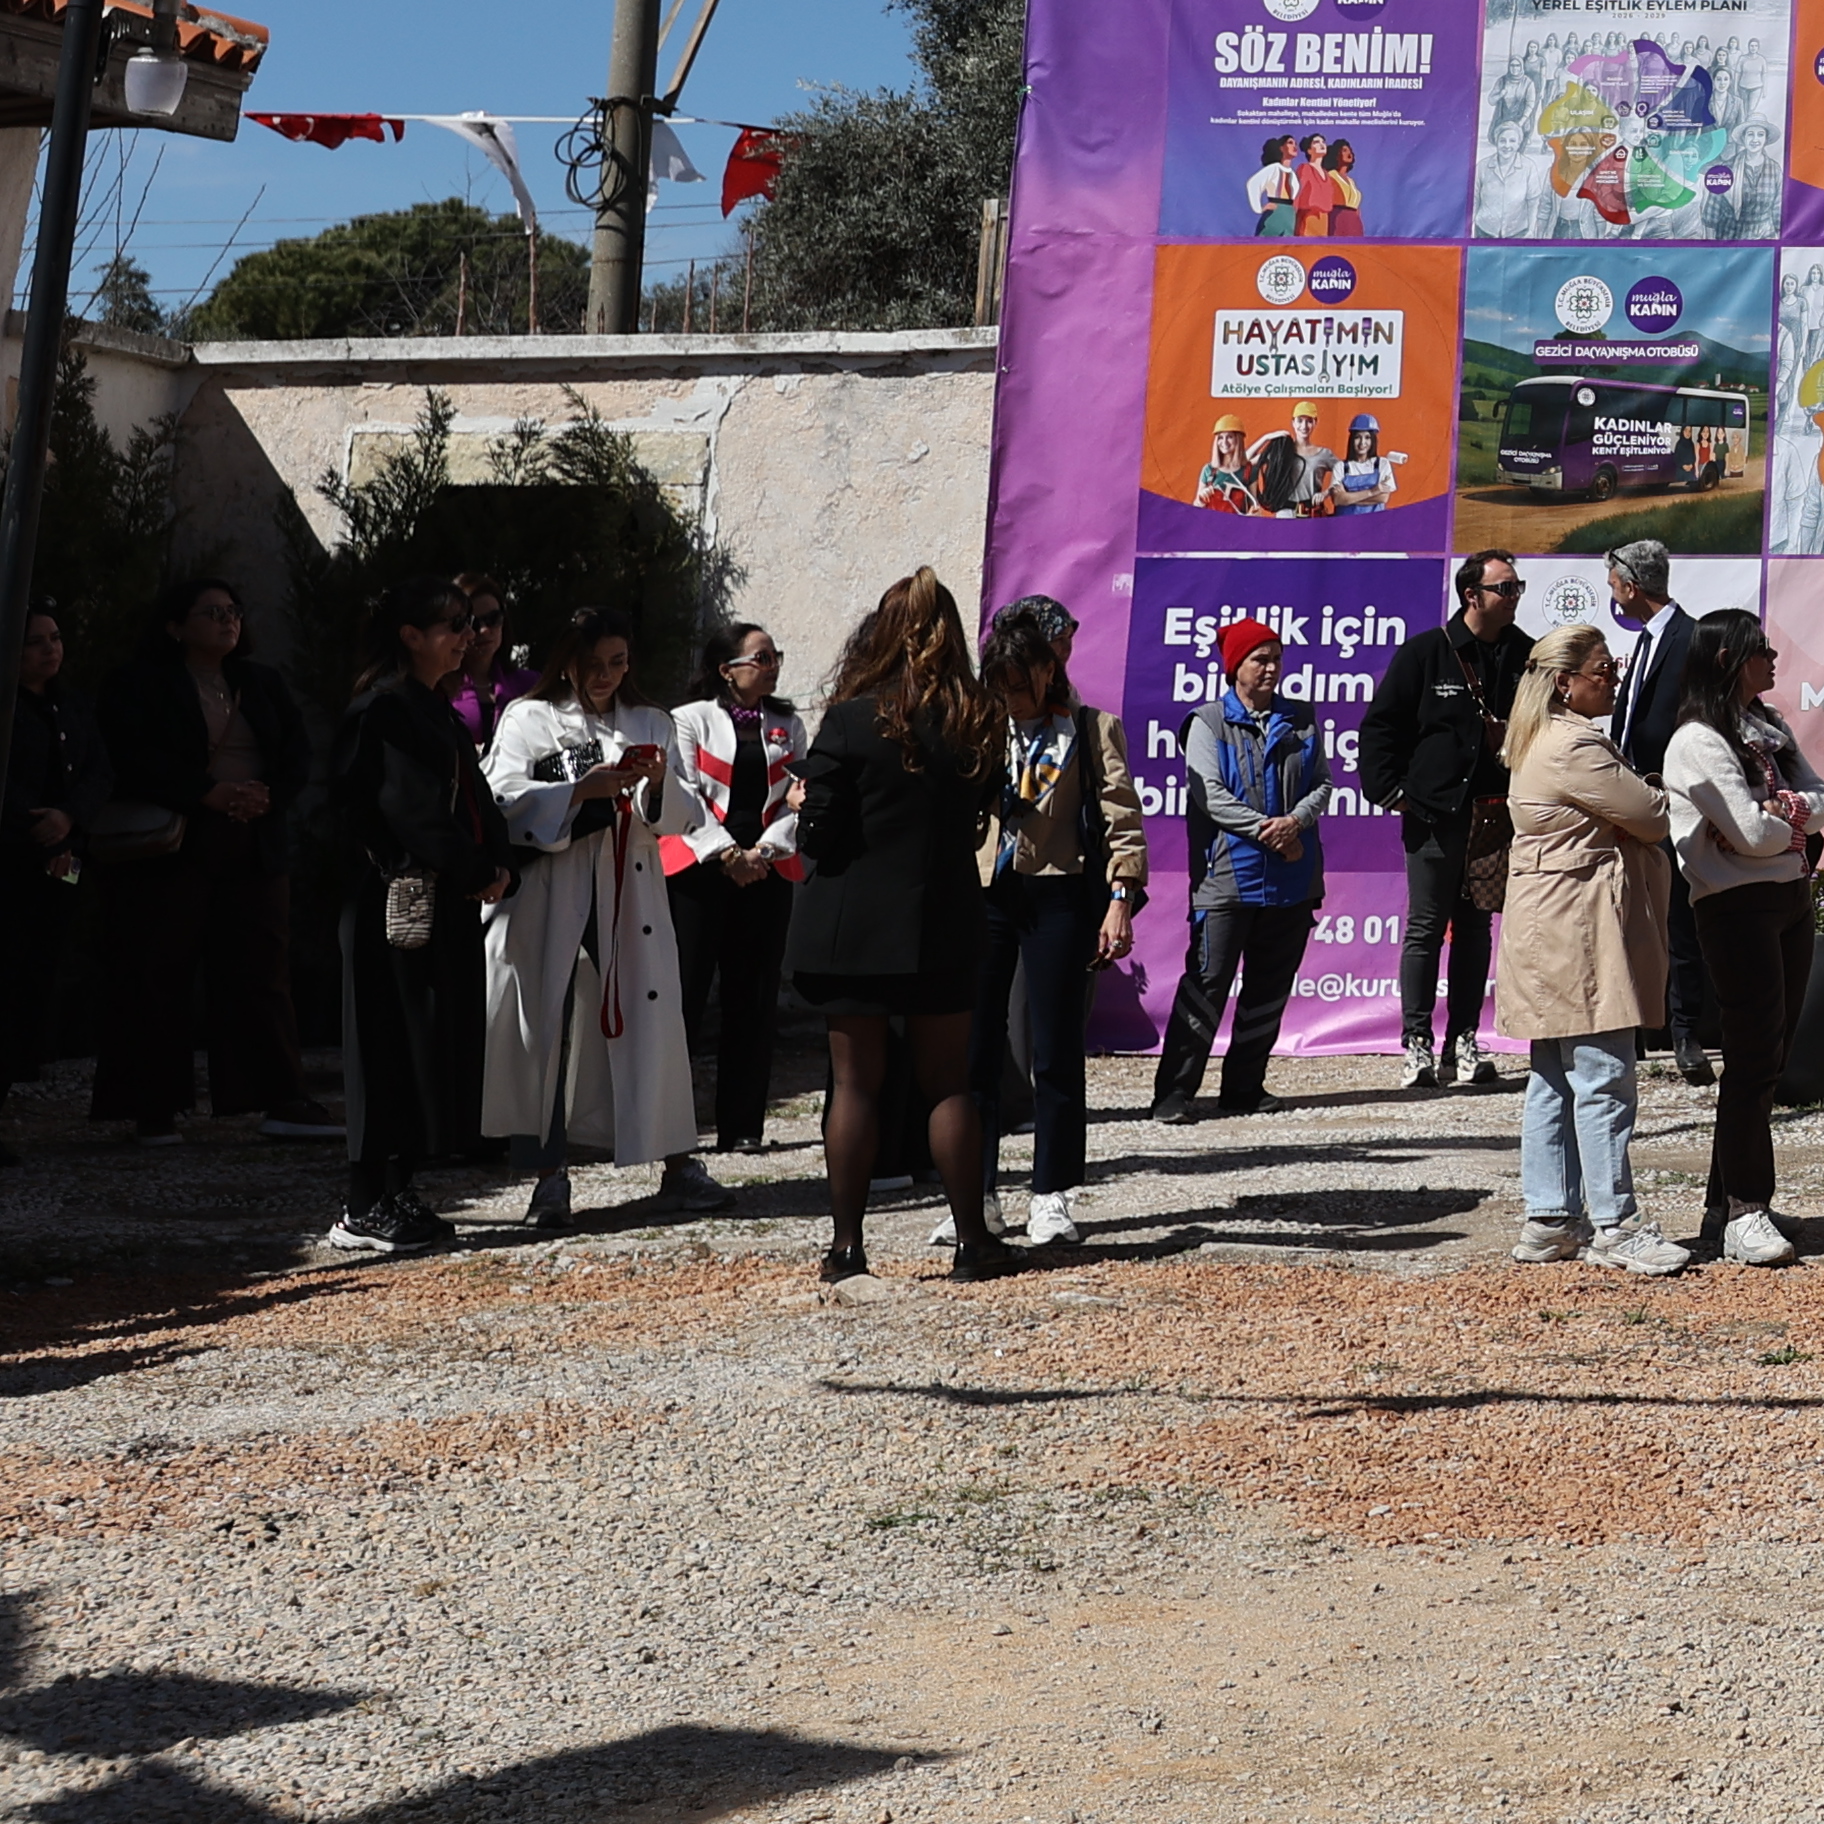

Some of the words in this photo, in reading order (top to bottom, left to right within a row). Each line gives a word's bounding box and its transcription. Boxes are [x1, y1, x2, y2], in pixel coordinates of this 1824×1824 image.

[1532, 0, 1581, 11] YEREL
[1646, 0, 1697, 11] EYLEM
[1700, 0, 1748, 12] PLANI
[1214, 25, 1288, 74] SÖZ
[1294, 26, 1434, 74] BENİM!
[1219, 76, 1289, 90] DAYANIŞMANIN
[1327, 77, 1384, 90] KADINLARIN
[1384, 76, 1423, 90] İRADESİ
[1311, 278, 1351, 290] KADIN
[1631, 291, 1678, 304] muğla
[1630, 303, 1678, 317] KADIN
[1222, 317, 1394, 353] HAYATIMIN
[1535, 343, 1573, 357] GEZİCİ
[1575, 345, 1646, 360] DA(YA)NIŞMA
[1646, 344, 1699, 358] OTOBÜSÜ
[1236, 349, 1379, 383] USTASIYIM
[1221, 383, 1261, 395] Atölye
[1264, 383, 1334, 397] Çalışmaları
[1337, 383, 1393, 397] Başlıyor!
[1593, 416, 1672, 434] KADINLAR
[1592, 432, 1672, 449] GÜÇLENİYOR
[1591, 446, 1618, 455] KENT
[1320, 604, 1406, 658] için
[1280, 663, 1374, 703] dım
[1313, 915, 1354, 944] 48
[1362, 915, 1399, 944] 01
